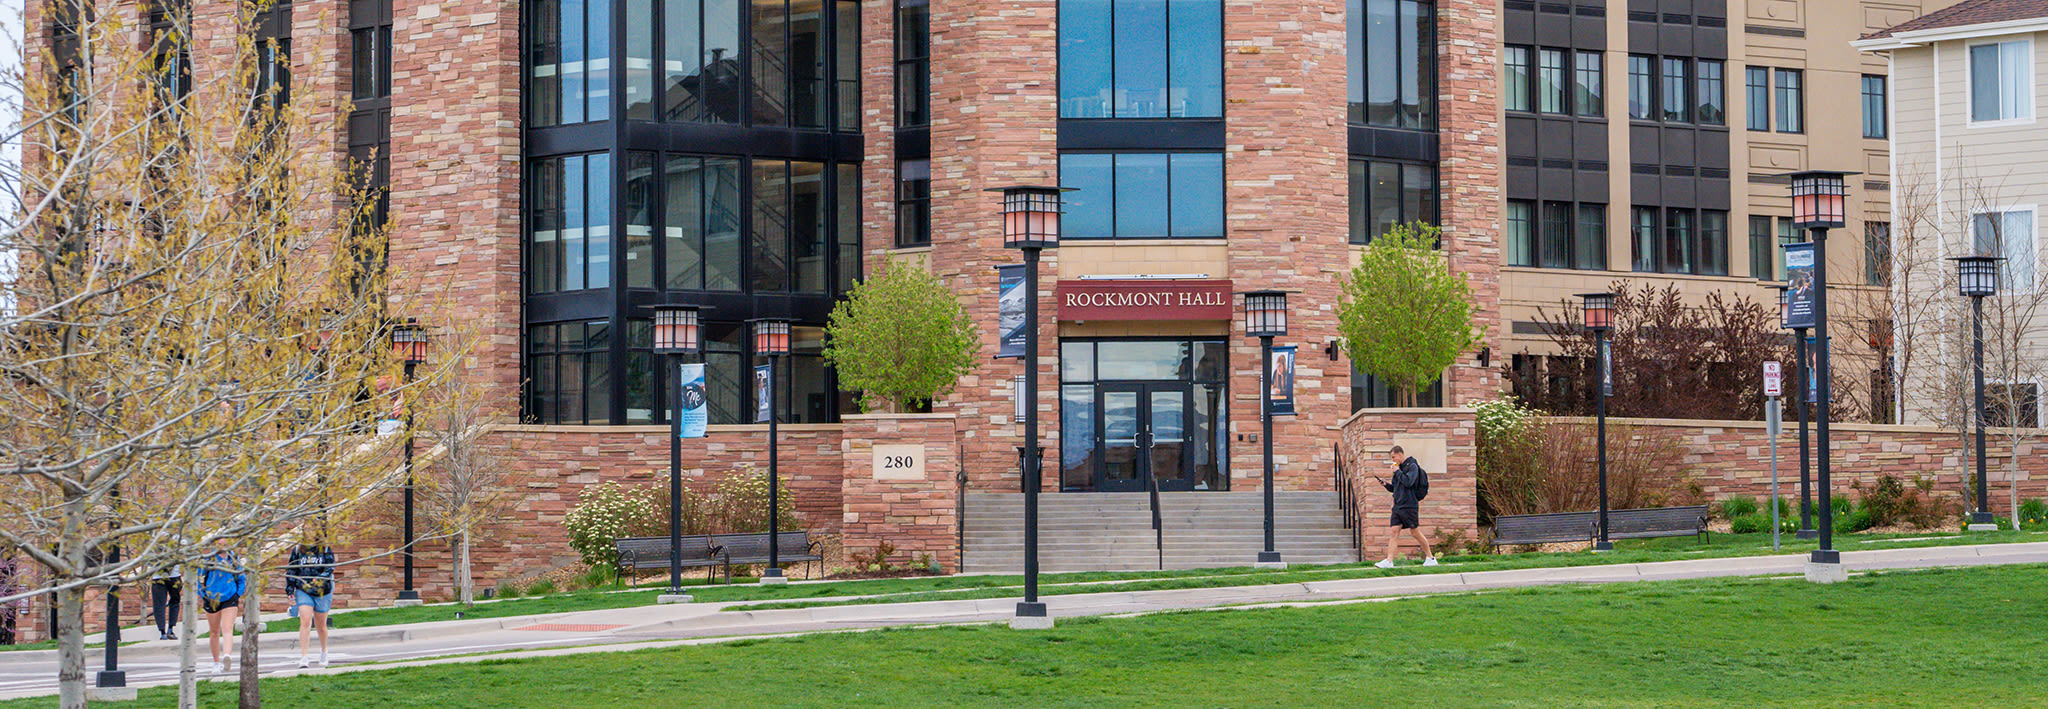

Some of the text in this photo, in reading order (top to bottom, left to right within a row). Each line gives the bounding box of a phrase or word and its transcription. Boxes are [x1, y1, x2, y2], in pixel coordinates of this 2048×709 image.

[1065, 292, 1226, 307] ROCKMONT HALL
[884, 455, 914, 469] 280
